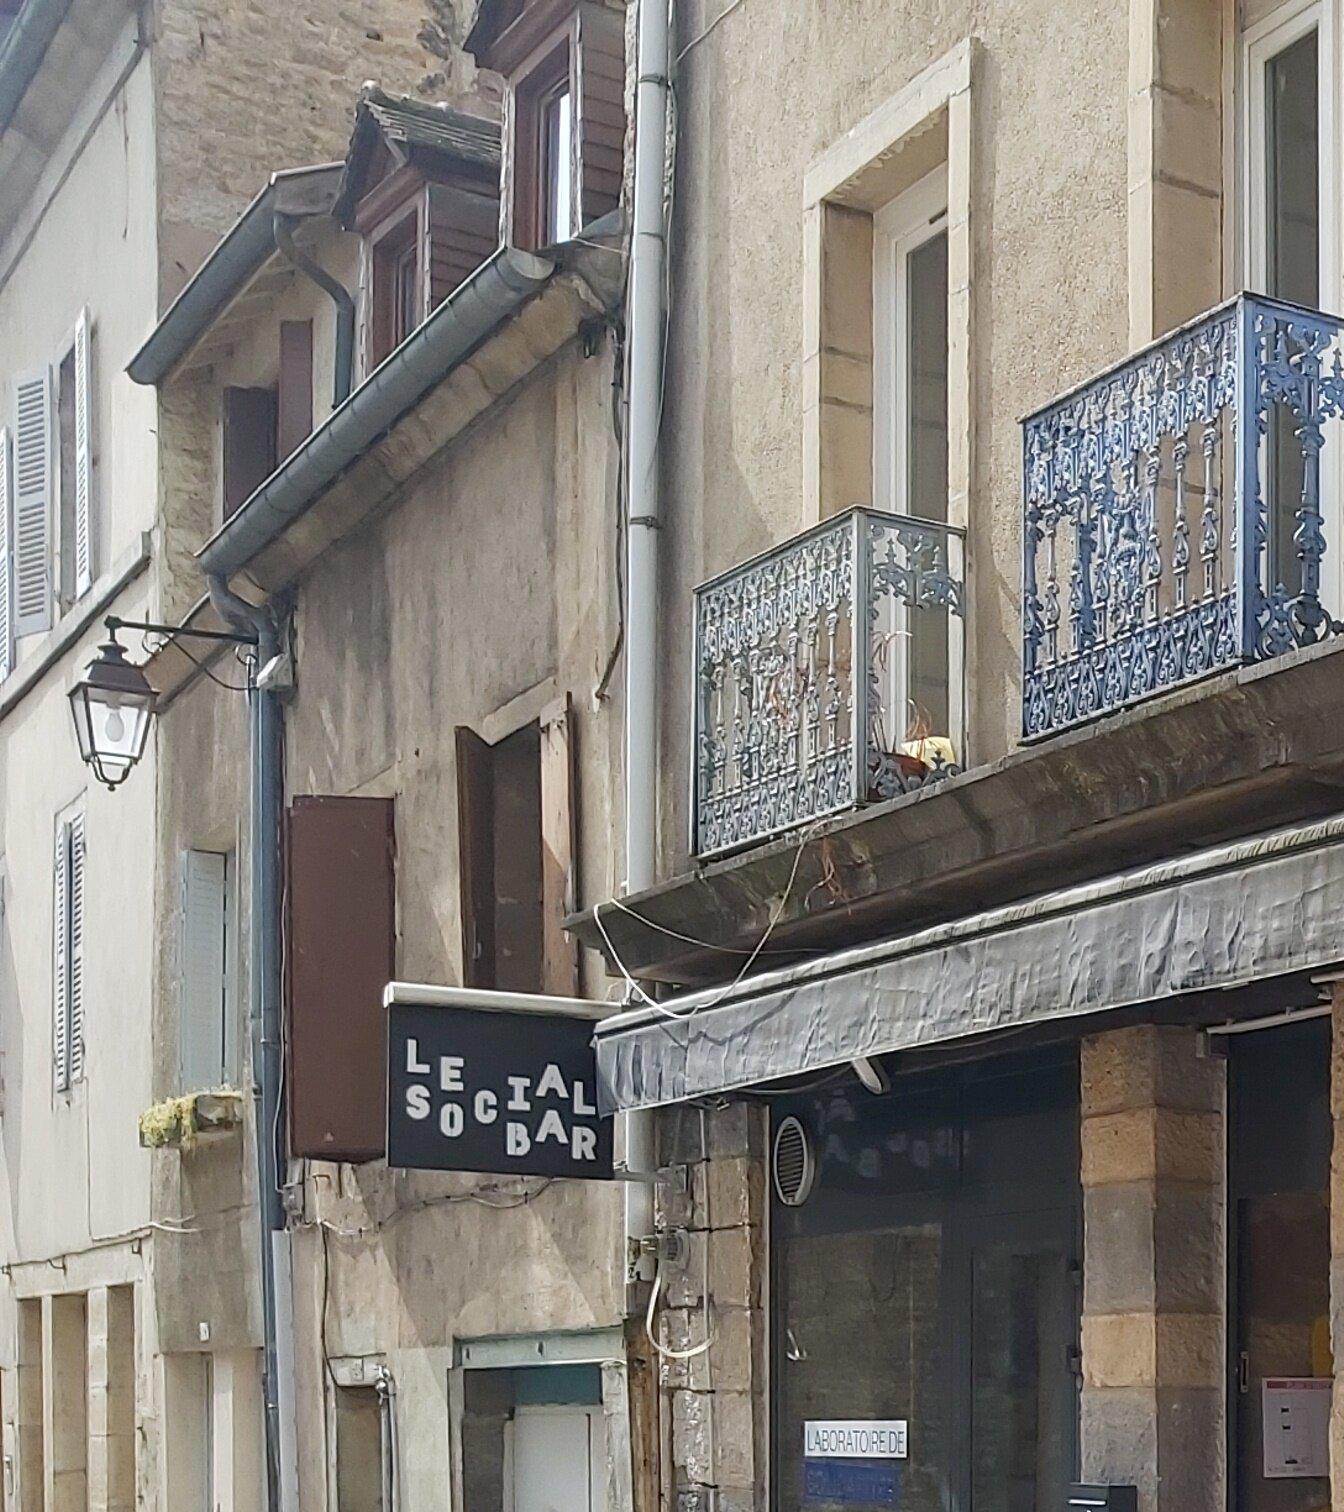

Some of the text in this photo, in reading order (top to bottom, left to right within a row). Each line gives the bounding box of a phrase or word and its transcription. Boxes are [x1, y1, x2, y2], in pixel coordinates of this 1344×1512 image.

[406, 1038, 464, 1092] LE
[506, 1109, 597, 1161] BAR
[807, 1429, 905, 1455] LABORATOIRE DE
